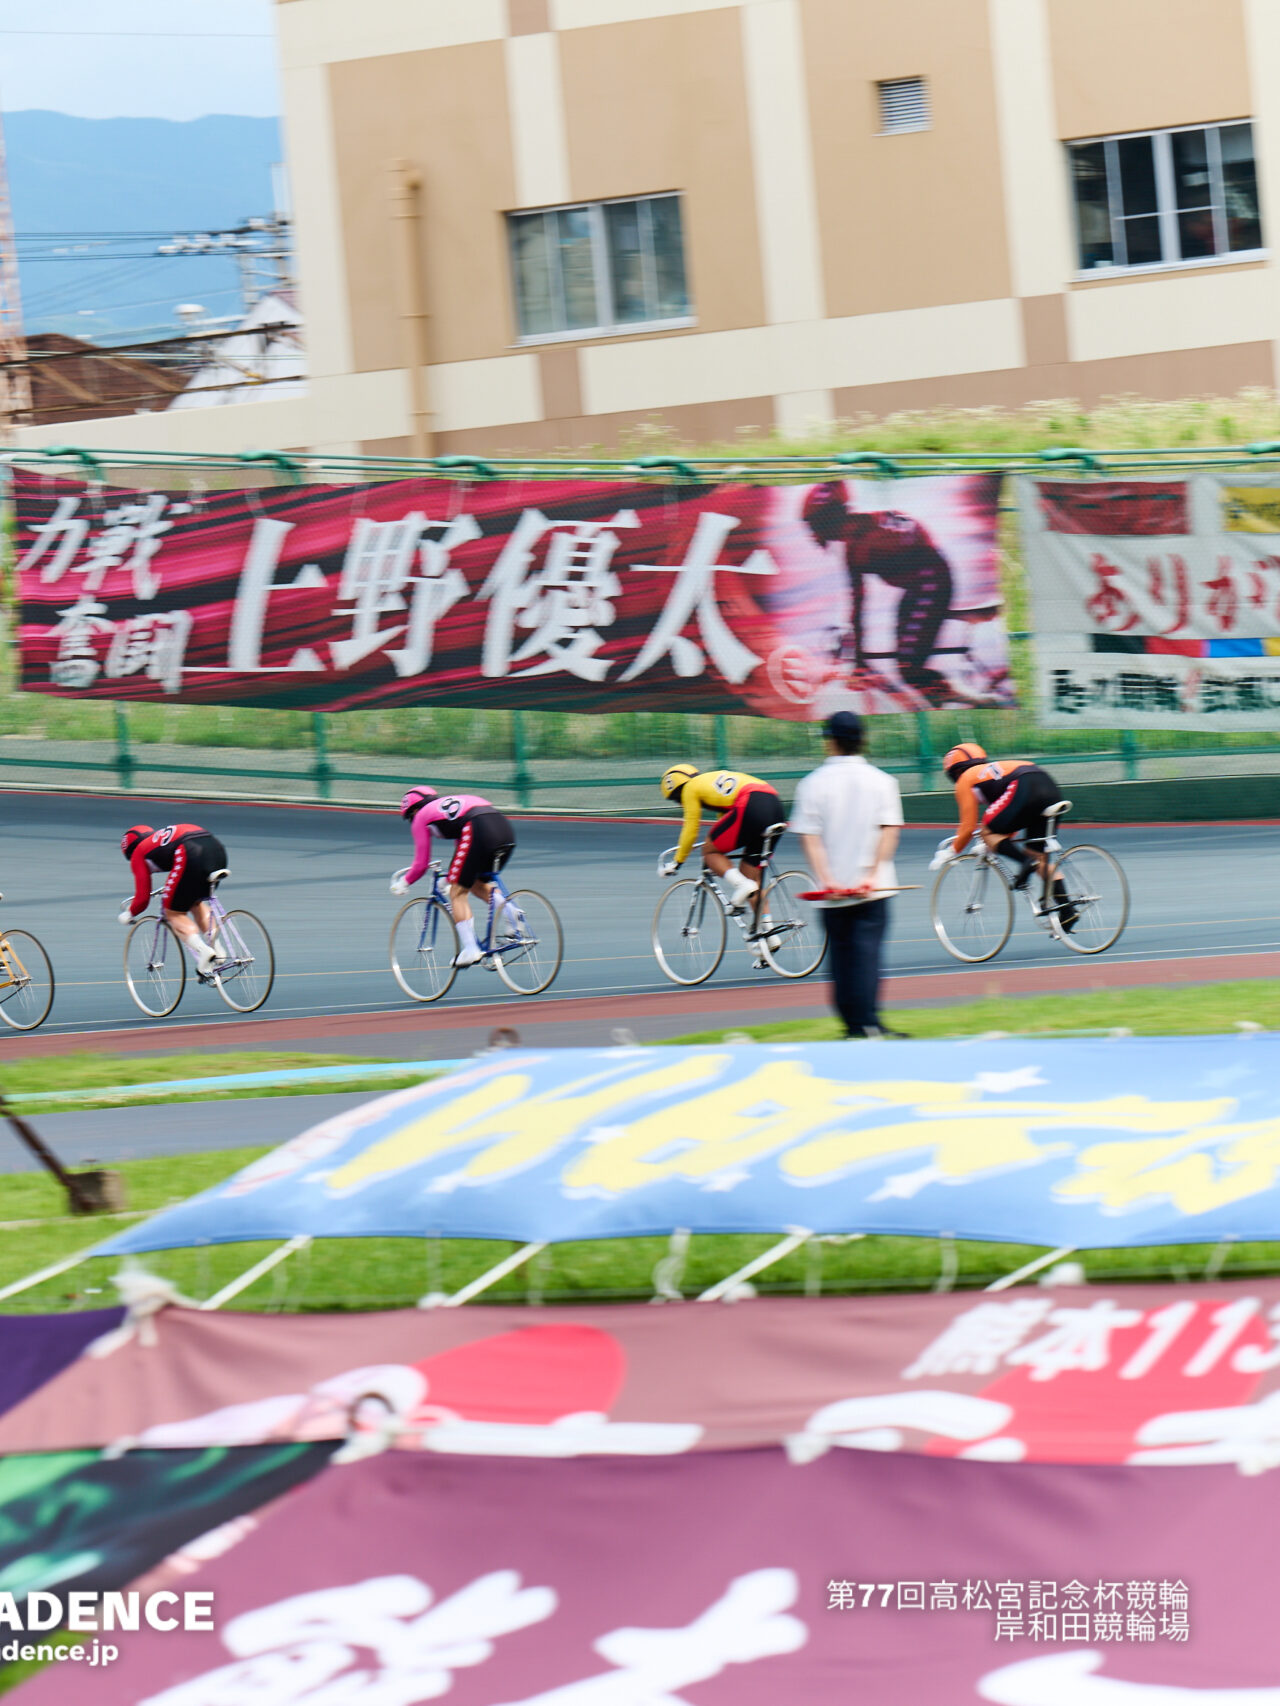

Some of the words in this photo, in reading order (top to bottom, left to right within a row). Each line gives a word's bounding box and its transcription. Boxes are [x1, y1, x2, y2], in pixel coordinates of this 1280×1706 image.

[182, 508, 779, 684] 上野優太
[1085, 552, 1280, 635] ありが
[715, 770, 738, 797] 5
[152, 825, 177, 847] 3
